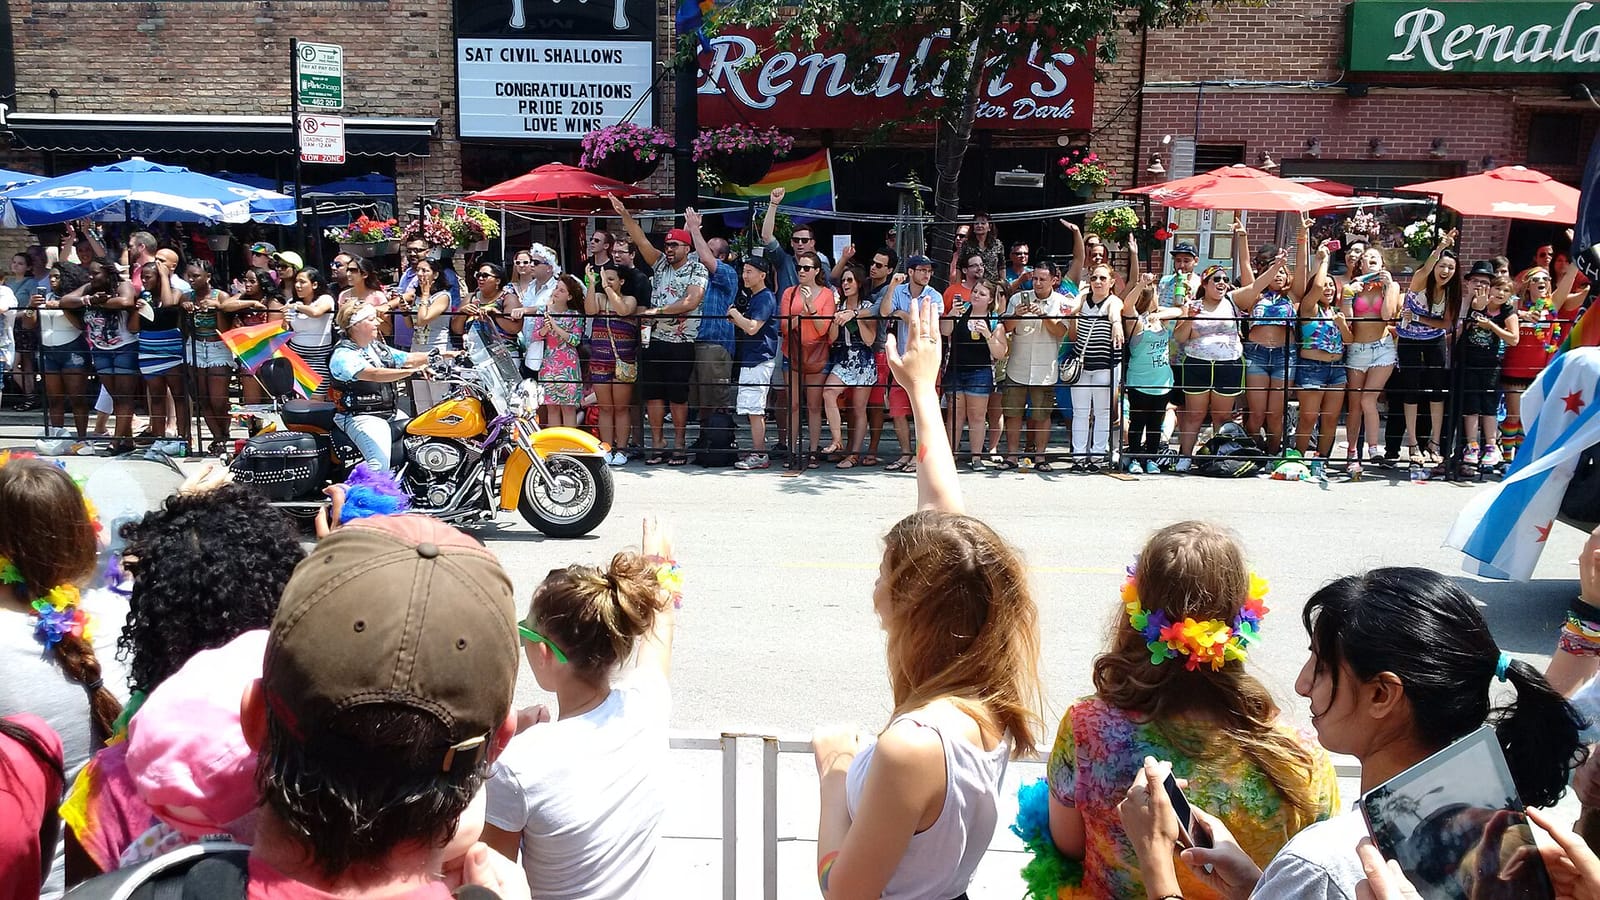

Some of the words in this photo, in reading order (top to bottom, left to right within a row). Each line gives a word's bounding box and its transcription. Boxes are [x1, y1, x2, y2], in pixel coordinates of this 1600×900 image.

[465, 48, 493, 63] SAT
[500, 48, 539, 63] CIVIL
[544, 49, 622, 64] SHALLOWS
[495, 82, 632, 99] CONGRATULATIONS
[518, 100, 563, 115] PRIDE
[571, 101, 604, 116] 2015
[1012, 98, 1075, 119] Dark
[524, 117, 558, 132] LOVE
[565, 119, 601, 132] WINS
